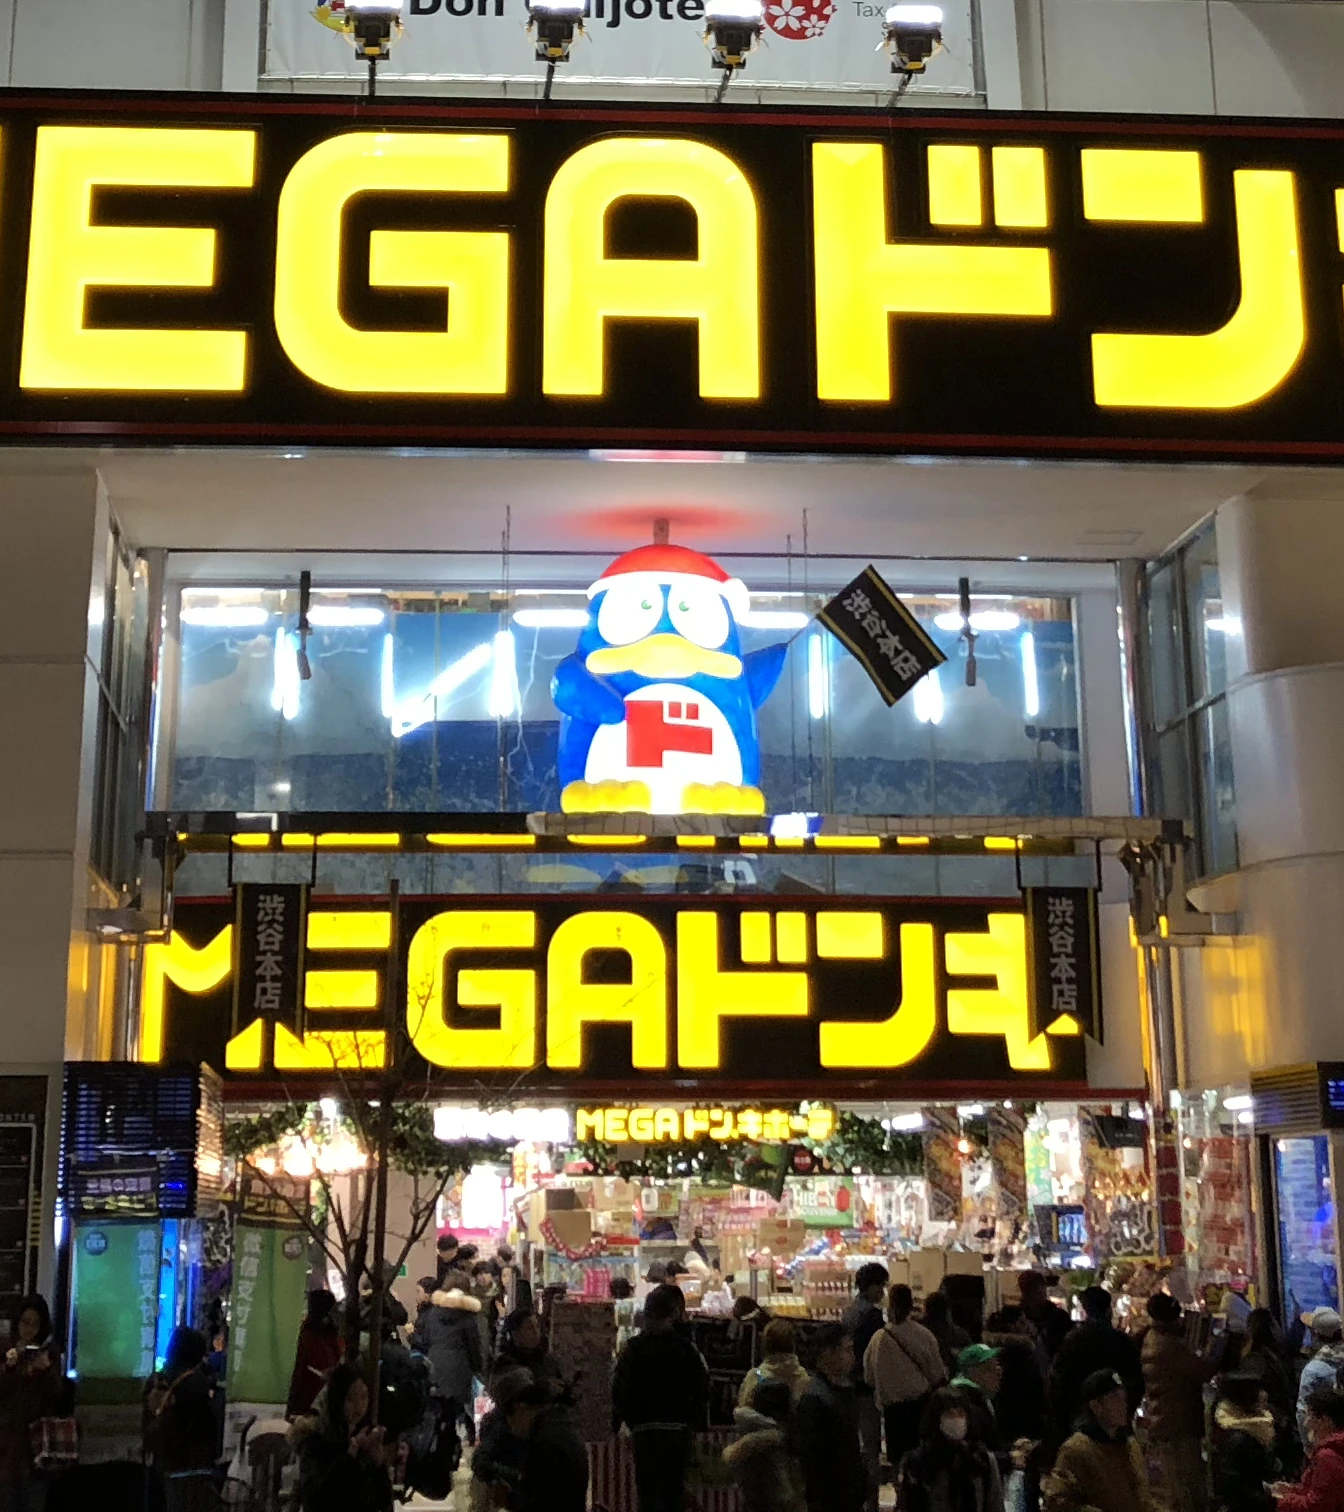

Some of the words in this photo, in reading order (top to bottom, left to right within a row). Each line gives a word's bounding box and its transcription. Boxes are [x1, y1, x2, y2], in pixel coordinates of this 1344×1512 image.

[841, 589, 922, 681] 渋谷本店
[626, 700, 712, 768] ド
[253, 893, 286, 1011] 渋谷本店
[1047, 896, 1079, 1012] 渋谷本店
